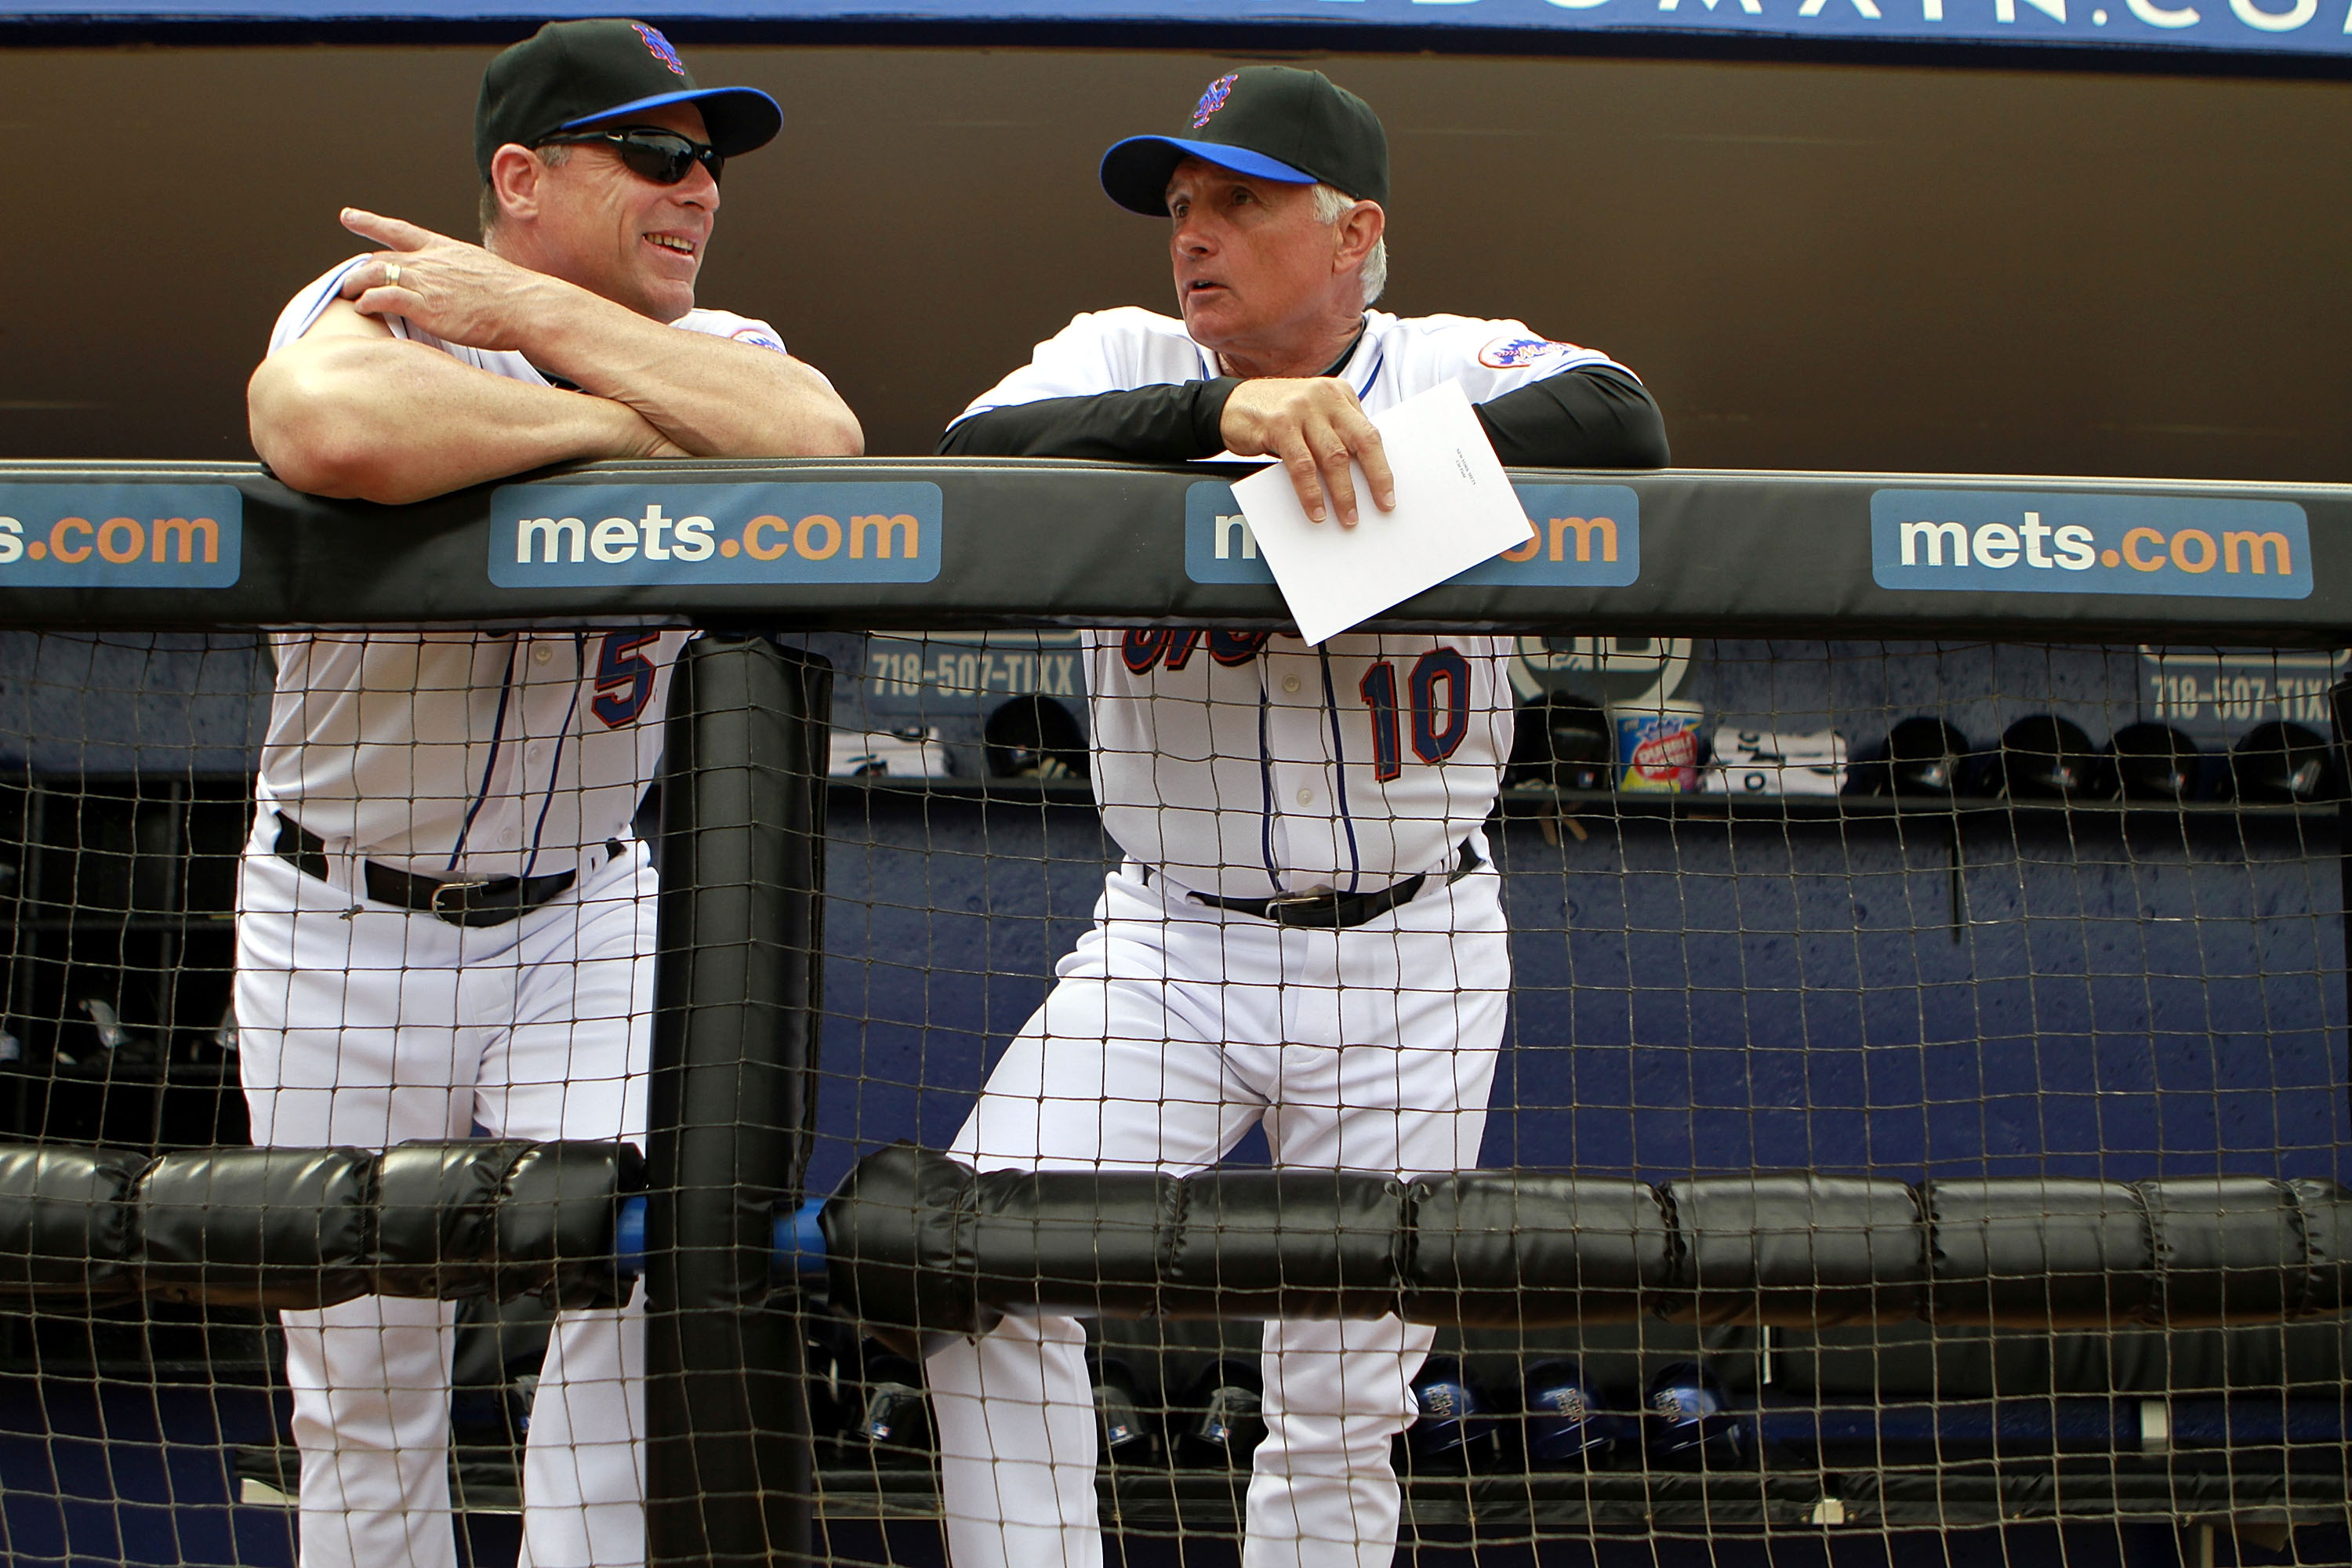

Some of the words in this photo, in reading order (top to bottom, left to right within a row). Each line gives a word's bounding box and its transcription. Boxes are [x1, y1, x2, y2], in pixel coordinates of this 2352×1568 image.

[517, 504, 919, 564] mets.com
[1900, 511, 2292, 575] mets.com
[591, 630, 660, 729] 5
[873, 652, 1074, 697] 718-507-TIXX
[1359, 646, 1472, 783] 10
